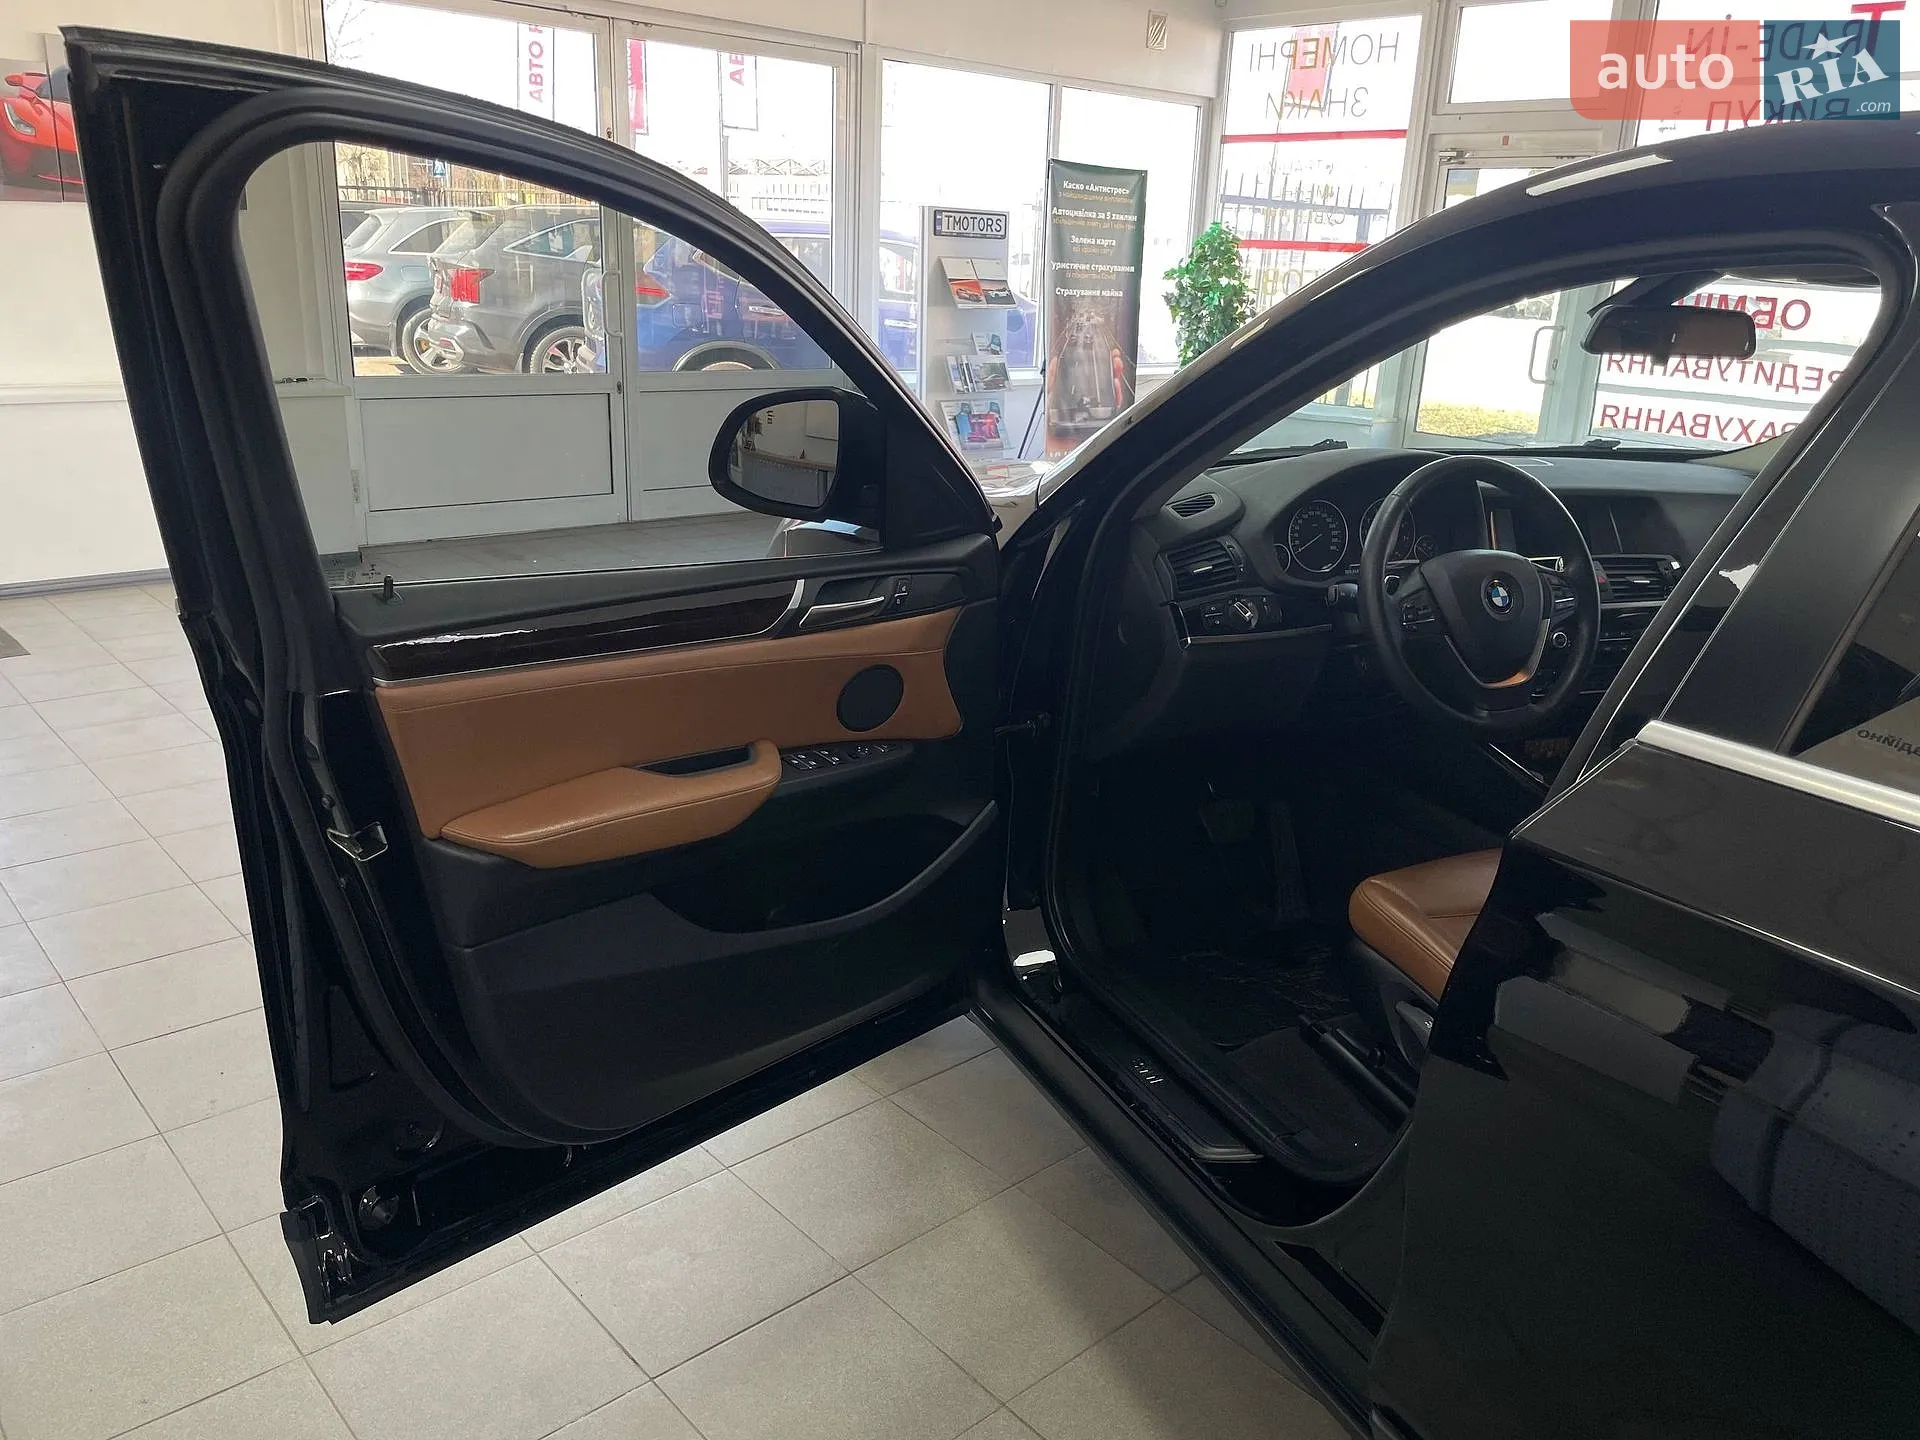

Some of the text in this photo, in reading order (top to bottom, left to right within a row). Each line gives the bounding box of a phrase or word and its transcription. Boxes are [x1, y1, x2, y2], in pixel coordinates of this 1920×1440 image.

[1063, 181, 1085, 190] Каско
[1106, 211, 1111, 219] 5
[944, 214, 1002, 232] TMOTORS
[1070, 235, 1117, 247] Зелена карта
[1090, 263, 1135, 273] страхування
[1055, 287, 1123, 297] Страхування майна
